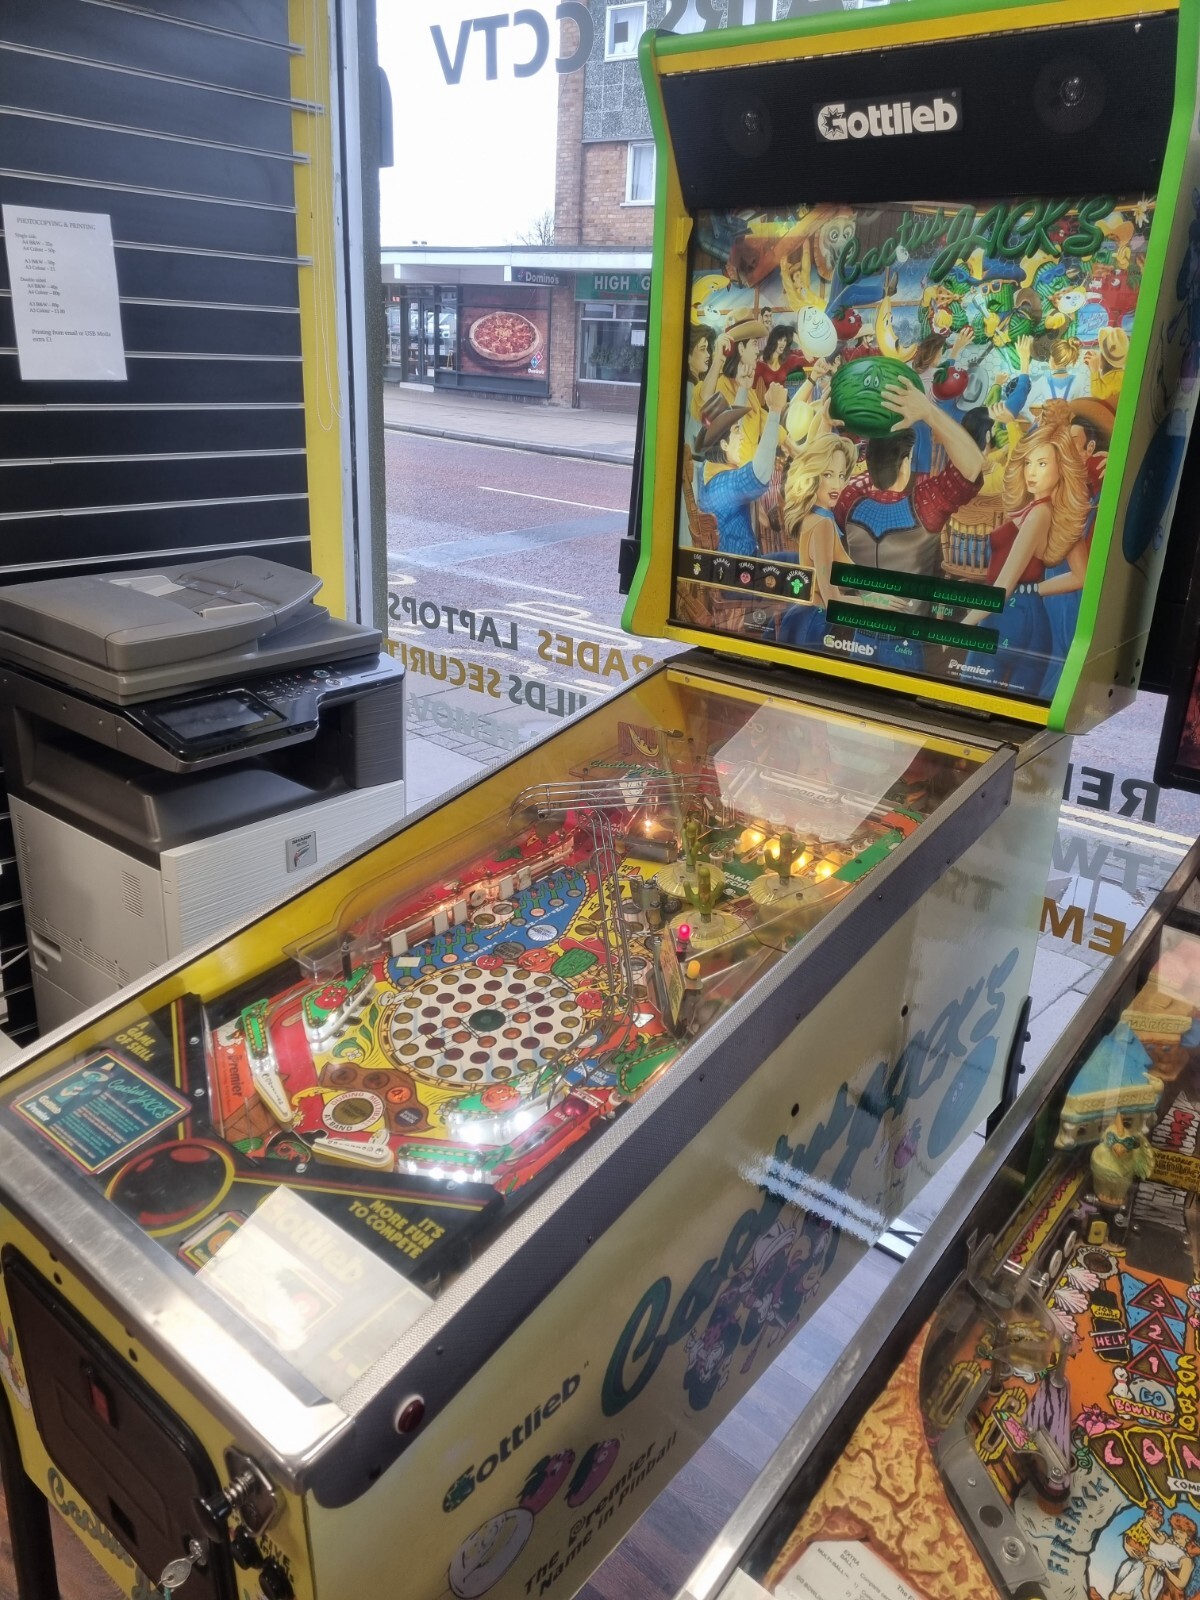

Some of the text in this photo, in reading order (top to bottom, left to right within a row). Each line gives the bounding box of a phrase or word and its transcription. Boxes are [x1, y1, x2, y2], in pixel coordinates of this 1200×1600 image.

[817, 98, 958, 141] Gottlieb
[17, 217, 63, 228] PHOTOCOPYING
[70, 222, 96, 231] PRINTING
[525, 271, 560, 285] Domino's
[594, 275, 630, 290] HIGH
[713, 558, 731, 567] BANANA
[762, 566, 780, 576] PUMPKIN
[1009, 597, 1016, 607] 2
[931, 605, 953, 617] MATCH
[823, 634, 875, 656] Gottlieb
[1002, 638, 1009, 648] 4
[948, 659, 992, 676] Premier
[136, 1021, 150, 1030] A
[126, 1027, 156, 1047] GAME
[115, 1034, 155, 1062] OF SKILL
[107, 1079, 147, 1096] Cactus
[348, 1200, 424, 1259] TO COMPETE
[369, 1200, 435, 1249] MORE FUN
[418, 1217, 446, 1239] IT'S
[1151, 1293, 1165, 1308] 3
[1096, 1334, 1125, 1346] HELP
[1148, 1324, 1164, 1341] 2
[1148, 1356, 1159, 1374] 1
[1177, 1355, 1198, 1430] COMBO
[1114, 1398, 1173, 1424] BOWLING
[442, 1372, 581, 1513] Gottlieb
[568, 1442, 656, 1548] Premier
[843, 1549, 860, 1566] EXTRA
[897, 1584, 908, 1597] The
